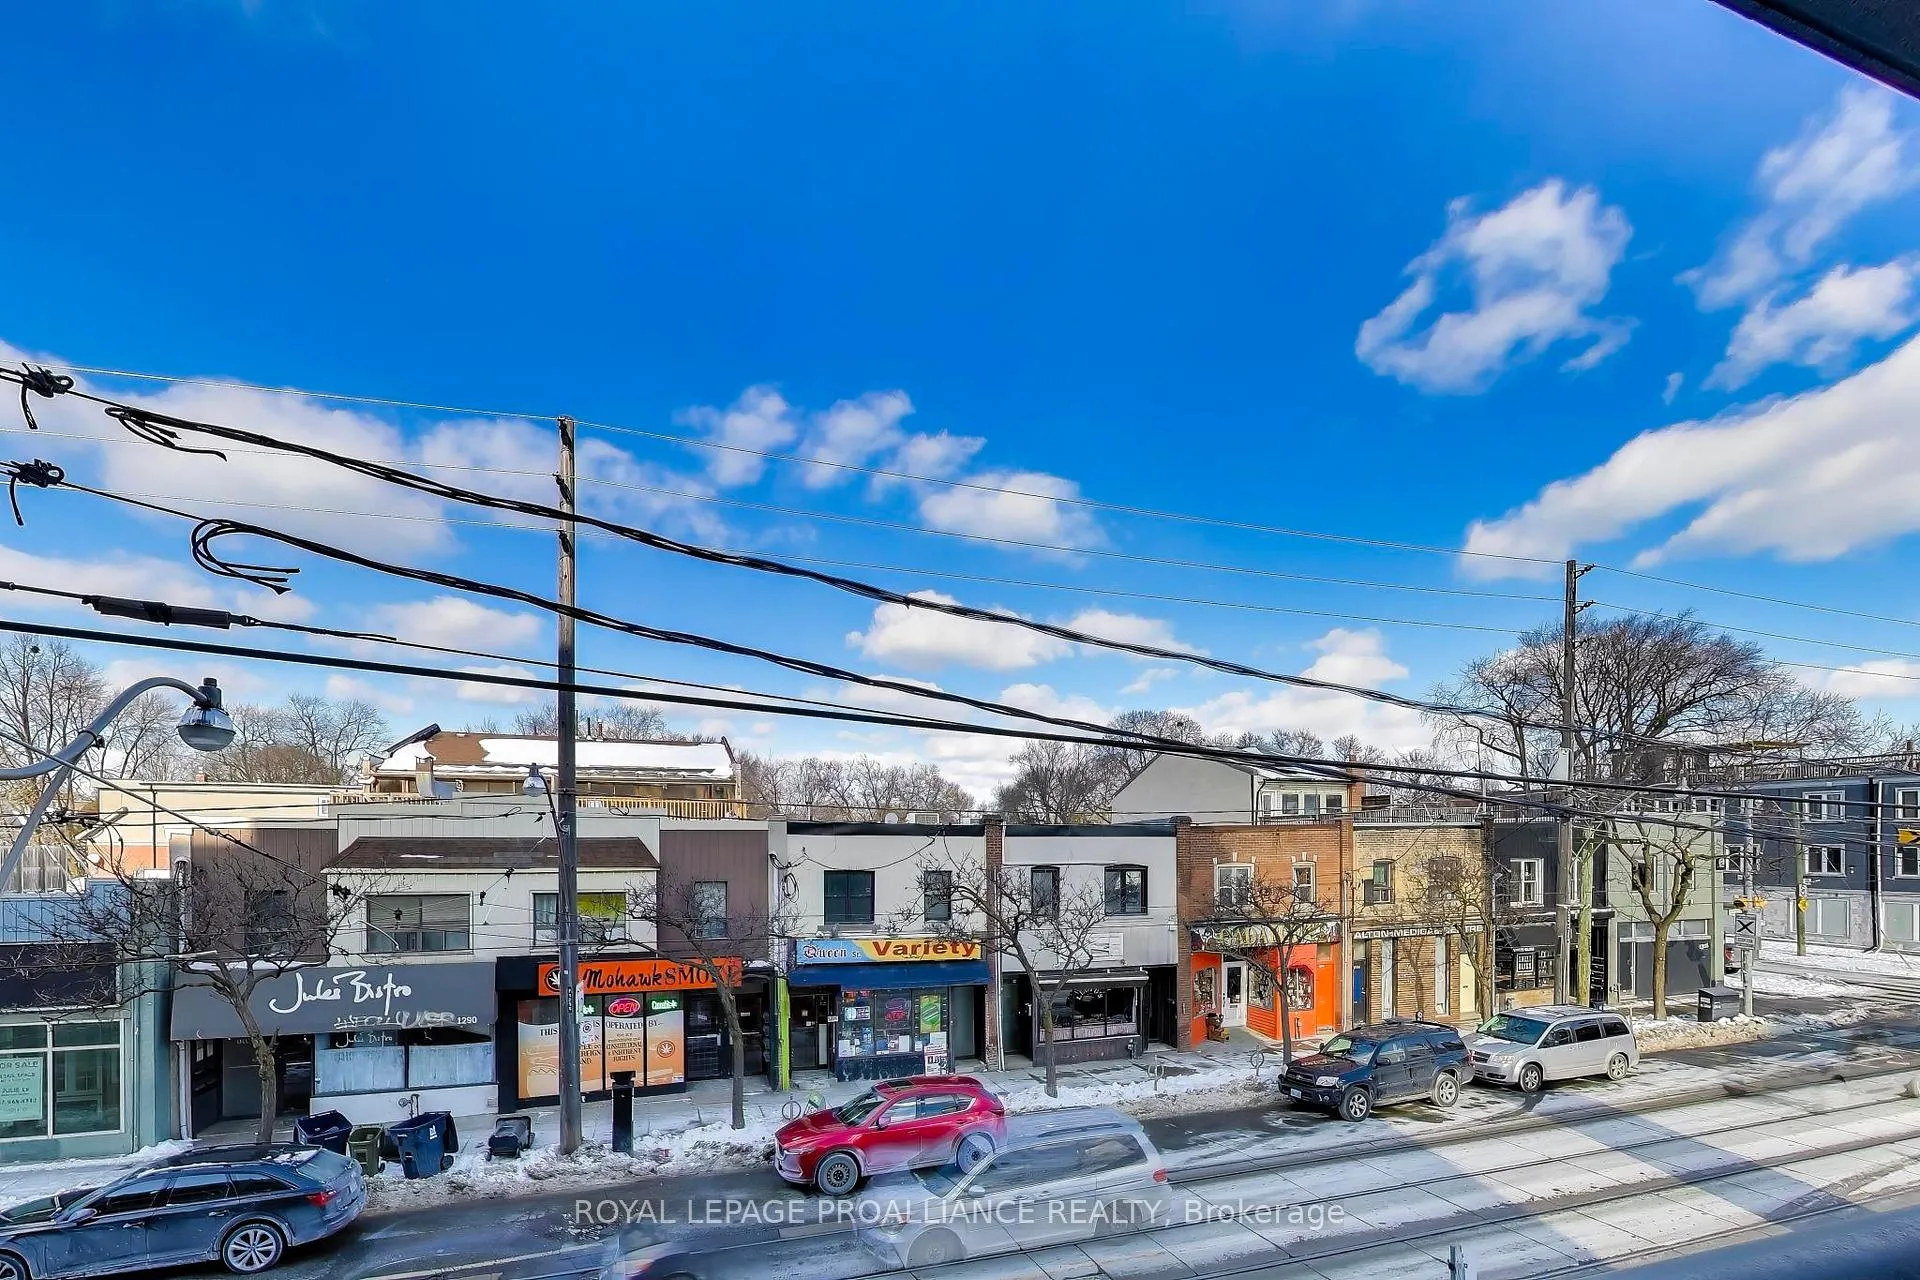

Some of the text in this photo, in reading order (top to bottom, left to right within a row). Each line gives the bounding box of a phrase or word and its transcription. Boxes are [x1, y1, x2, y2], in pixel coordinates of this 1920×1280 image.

[1353, 931, 1391, 939] ALTON
[1443, 924, 1484, 935] CETRE
[803, 944, 847, 958] Queen
[872, 941, 976, 957] Variety
[583, 964, 664, 989] Mohawk
[332, 970, 412, 1016] Bistro
[611, 1002, 638, 1013] OPEN
[456, 1016, 477, 1024] 1290
[540, 1028, 558, 1036] THIS
[605, 1020, 643, 1030] OPERATED
